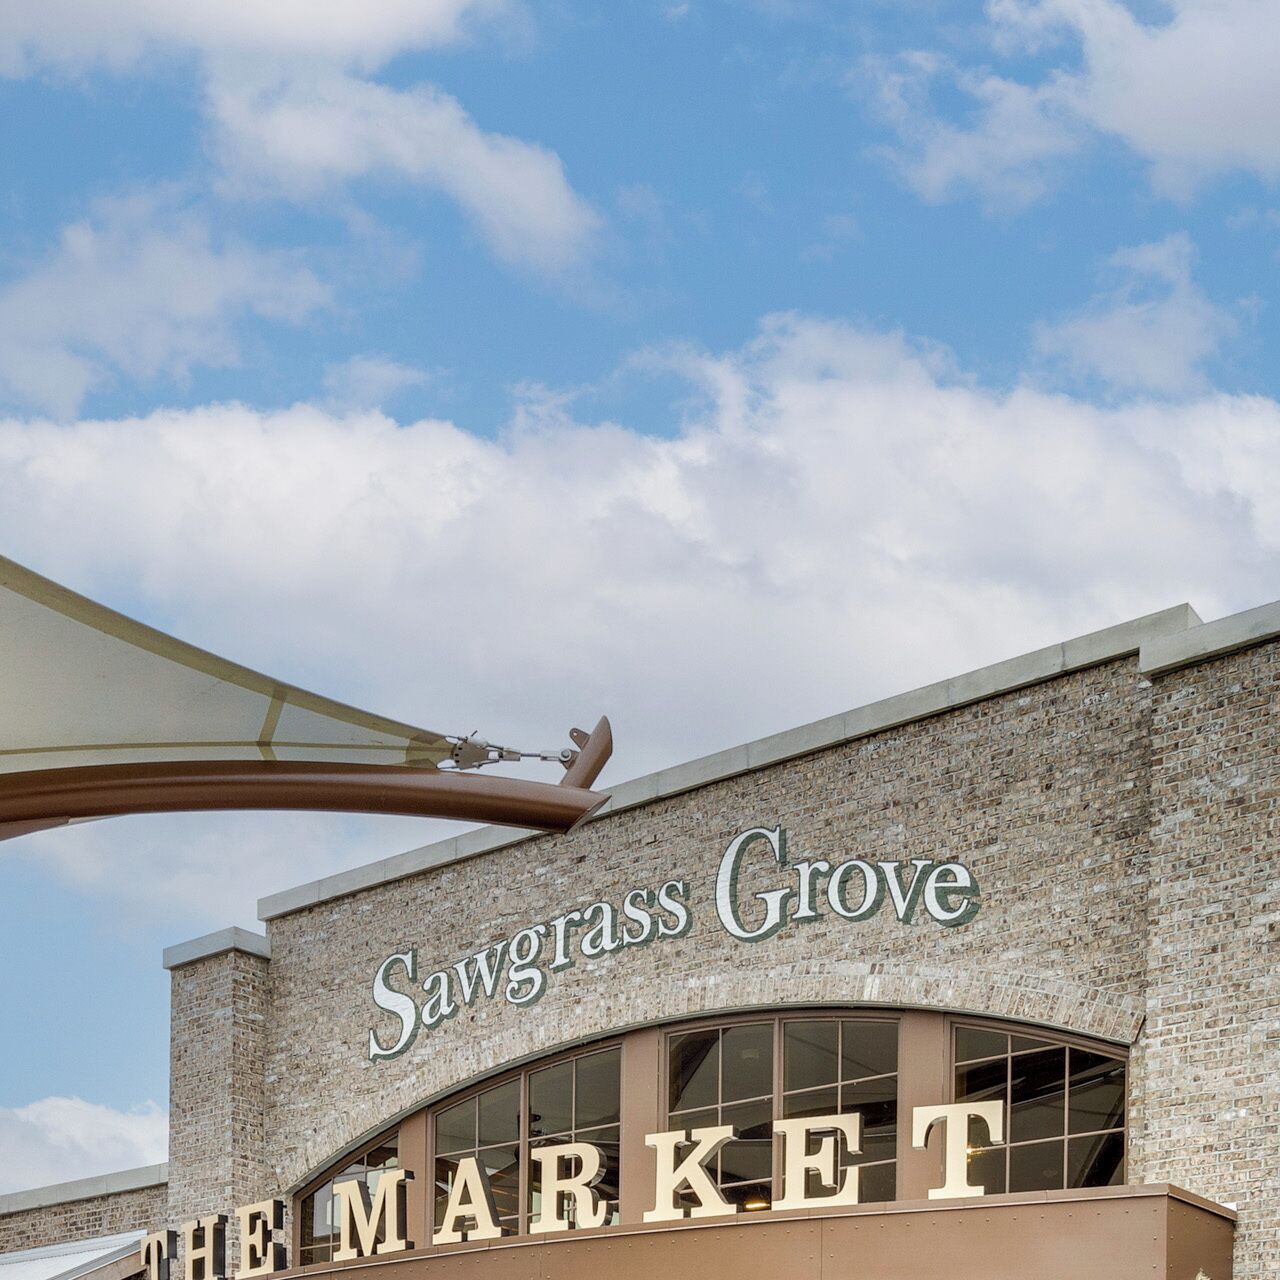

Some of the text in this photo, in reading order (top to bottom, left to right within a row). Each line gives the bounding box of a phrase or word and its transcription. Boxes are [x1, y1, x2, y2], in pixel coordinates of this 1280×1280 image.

[368, 825, 980, 1062] Sawgrass Grove
[332, 1100, 1004, 1262] MARKET
